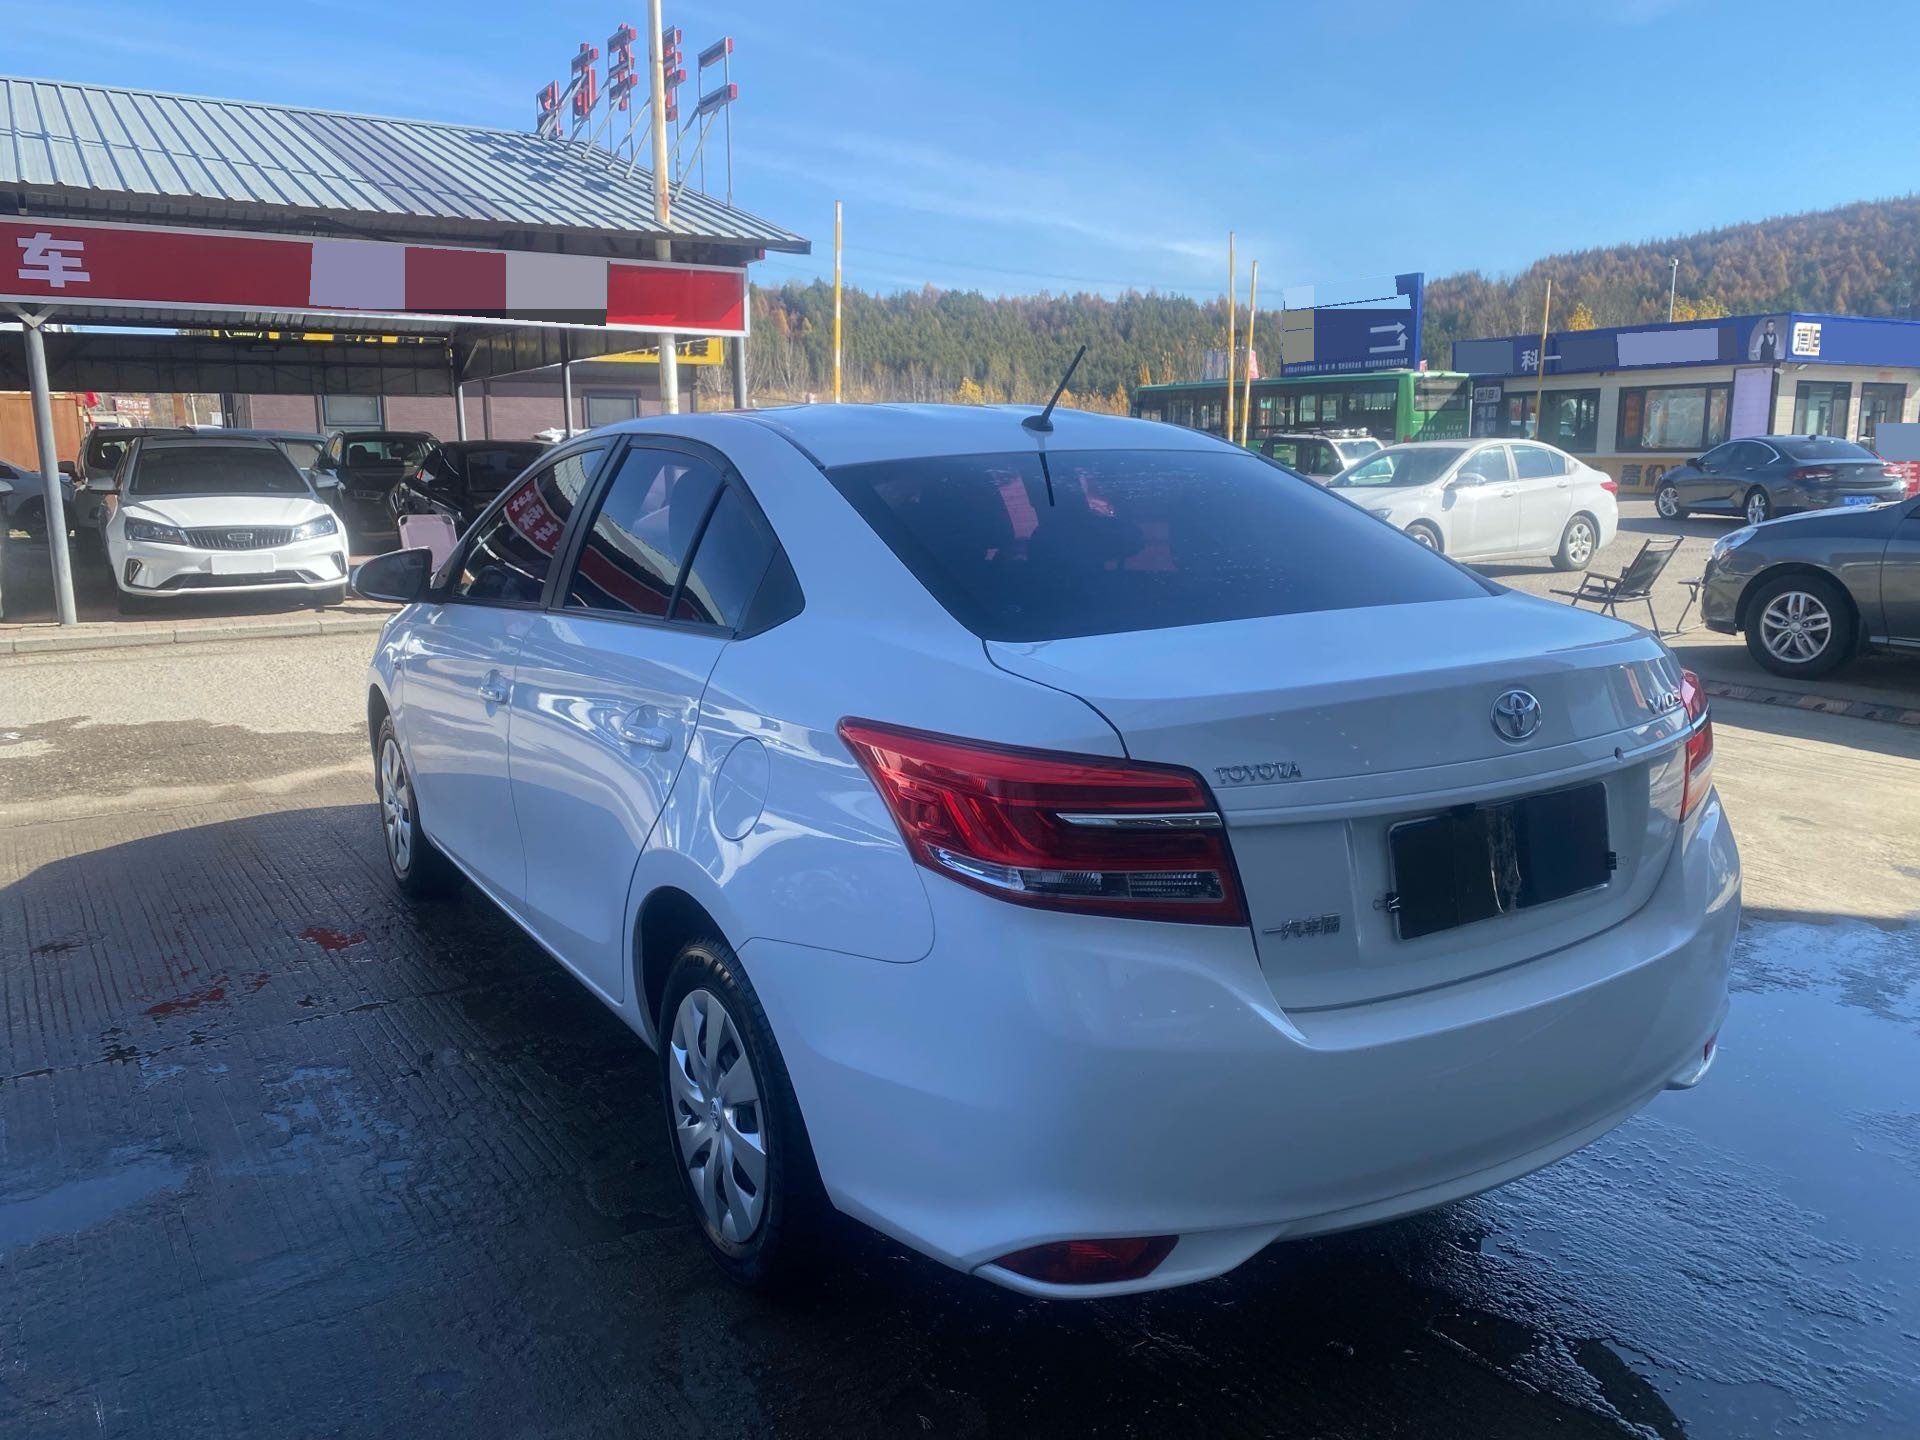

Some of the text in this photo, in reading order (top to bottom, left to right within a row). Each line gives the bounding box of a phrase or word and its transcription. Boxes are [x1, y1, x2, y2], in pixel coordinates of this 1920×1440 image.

[16, 232, 91, 288] 车
[1521, 349, 1561, 372] 科一
[1213, 760, 1302, 785] TOYOTA
